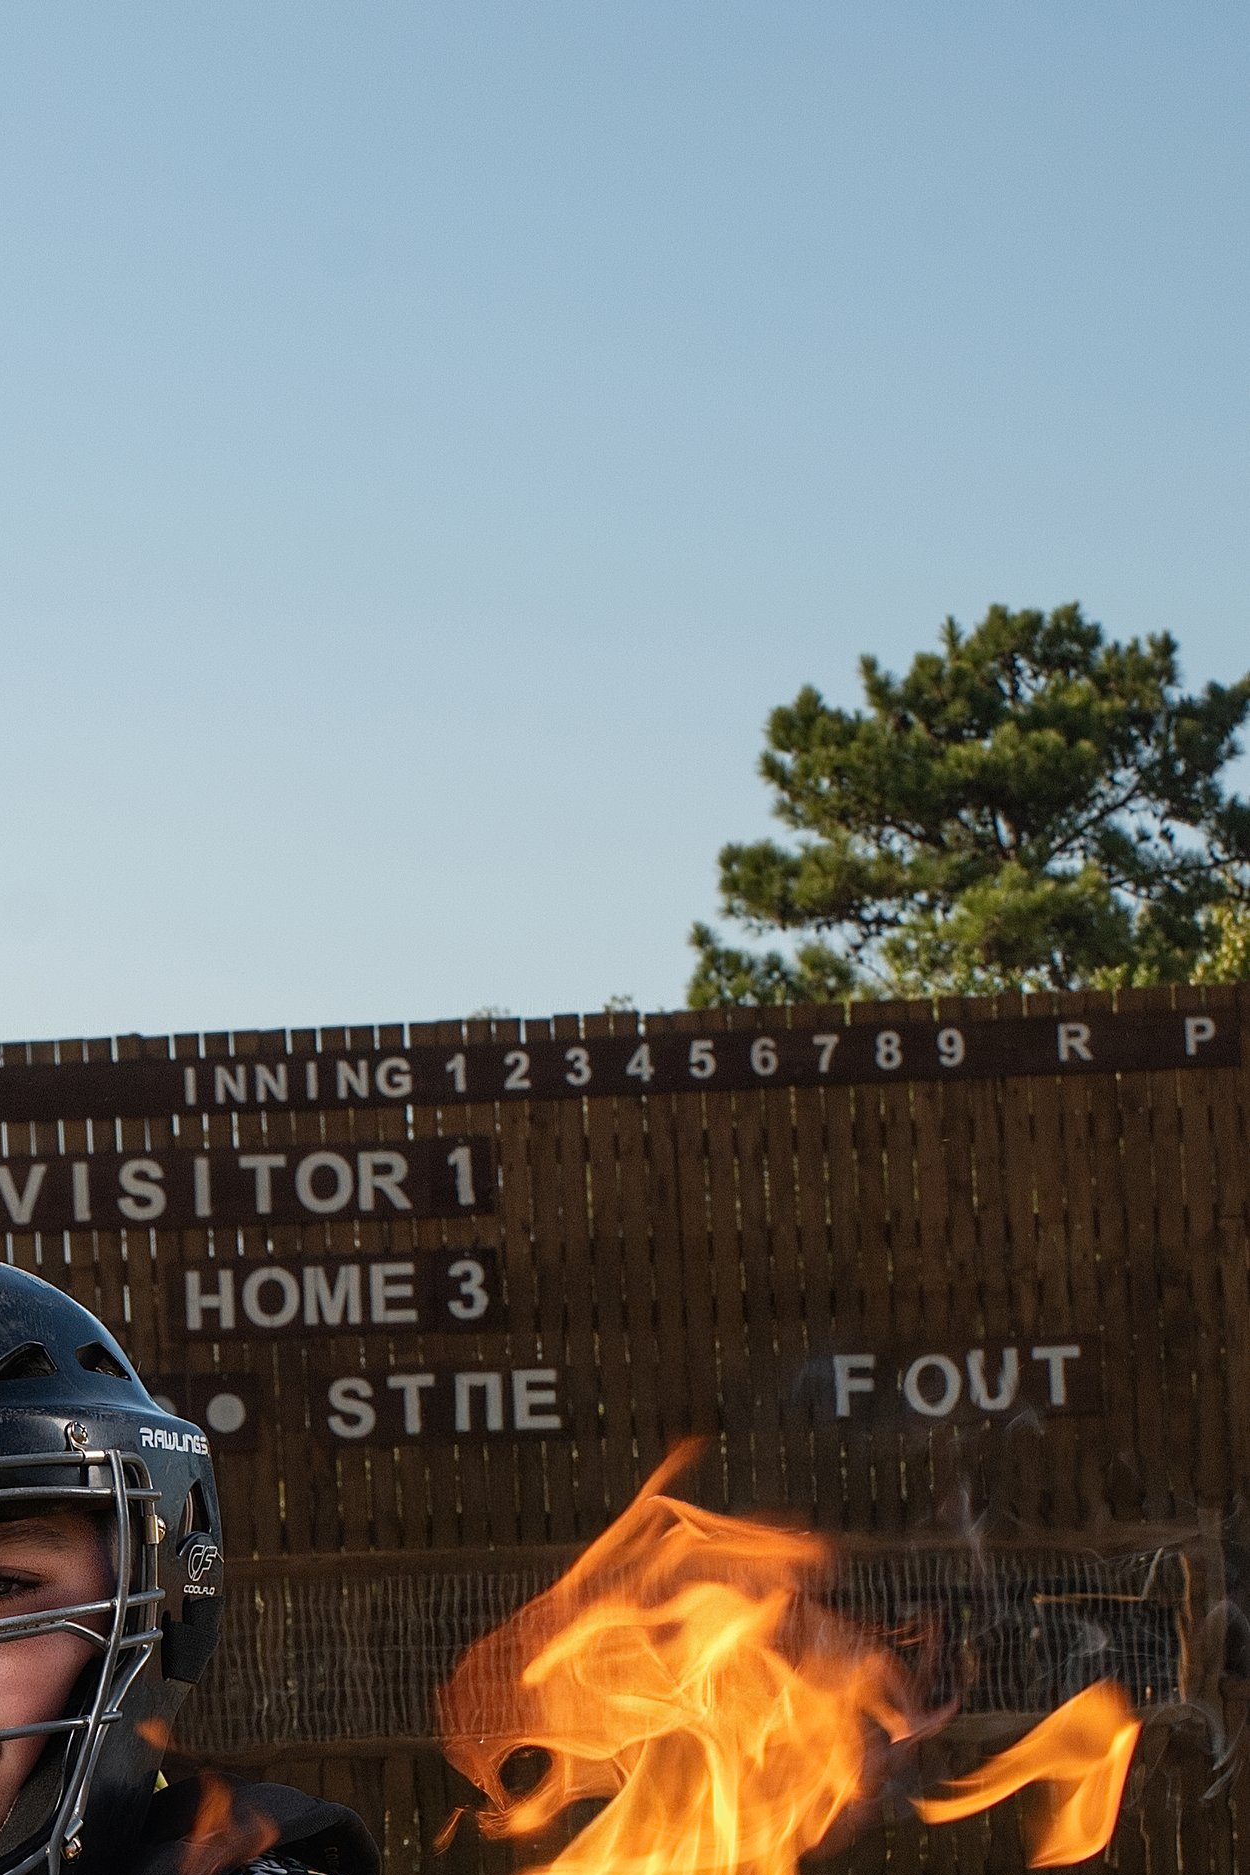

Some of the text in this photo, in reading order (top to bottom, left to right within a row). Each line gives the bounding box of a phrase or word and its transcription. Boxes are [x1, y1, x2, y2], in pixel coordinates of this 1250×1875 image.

[183, 1015, 1217, 1106] INNING 1 2 3 4 5 6 7 8 9 R P
[446, 1146, 477, 1207] 1
[184, 1259, 490, 1331] HOME 3
[139, 1427, 209, 1456] RAWLINGS
